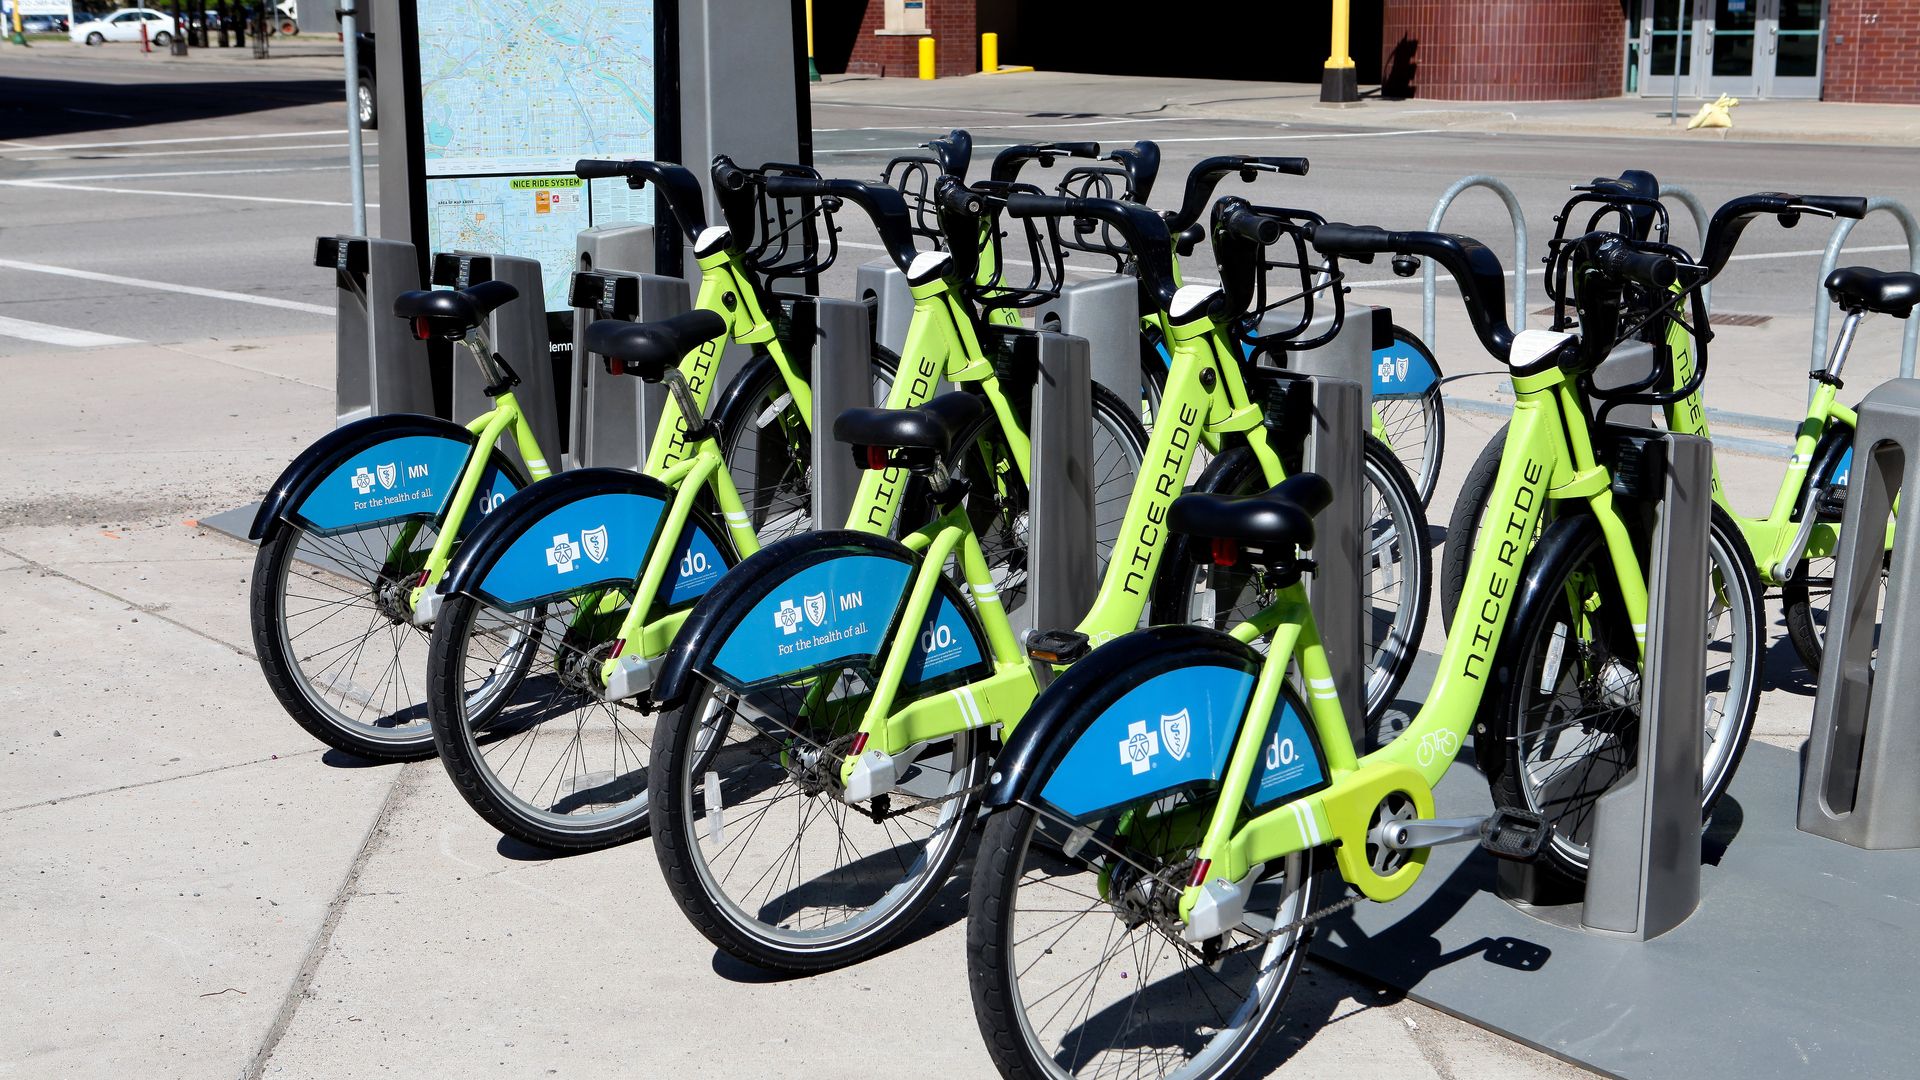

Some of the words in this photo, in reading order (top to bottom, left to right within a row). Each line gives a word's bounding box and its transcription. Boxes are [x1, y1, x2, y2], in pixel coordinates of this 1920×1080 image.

[513, 180, 530, 188] NICE
[550, 178, 580, 187] SYSTEM
[661, 415, 689, 470] NIC
[688, 340, 717, 395] RID
[408, 463, 429, 479] MN
[354, 500, 368, 510] For
[369, 497, 383, 507] the
[384, 492, 410, 505] health
[411, 490, 420, 500] of
[421, 488, 433, 498] all.
[1122, 501, 1167, 596] NICE
[1155, 402, 1198, 498] RIDE
[1463, 572, 1508, 680] NICE
[1497, 458, 1543, 567] RIDE
[839, 590, 863, 611] MN
[778, 643, 794, 656] For
[795, 638, 812, 652] the
[813, 630, 842, 647] health
[844, 626, 853, 638] of
[854, 623, 868, 635] all.
